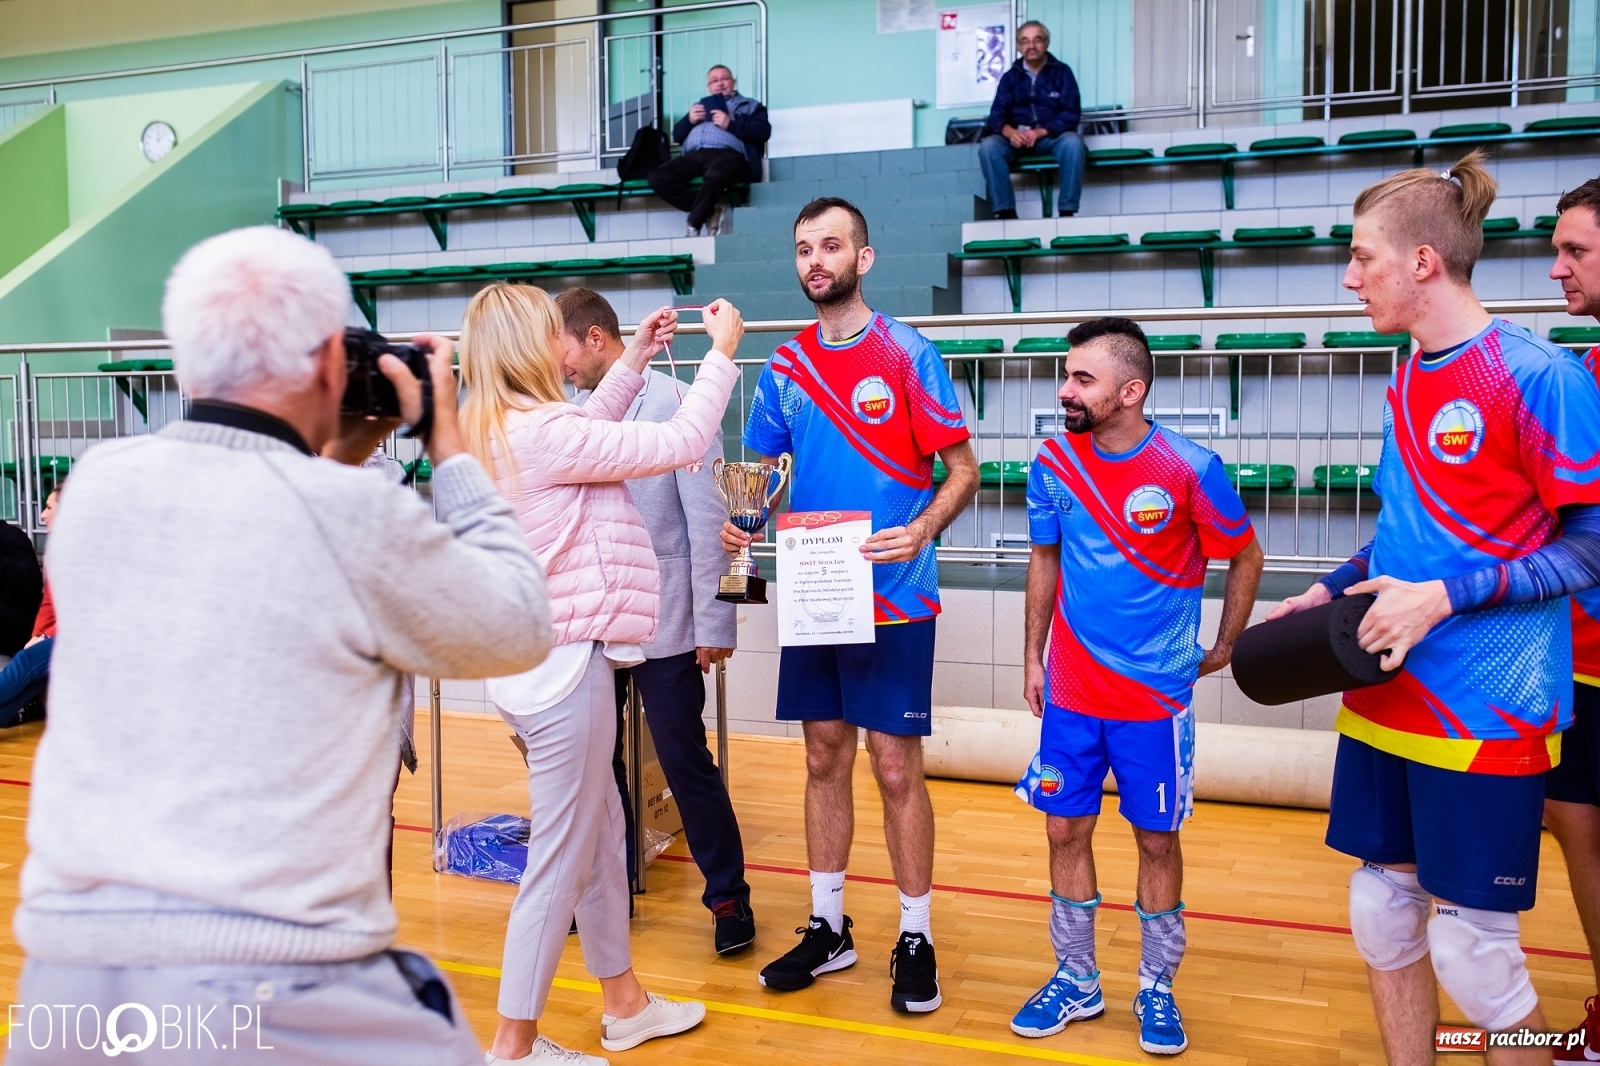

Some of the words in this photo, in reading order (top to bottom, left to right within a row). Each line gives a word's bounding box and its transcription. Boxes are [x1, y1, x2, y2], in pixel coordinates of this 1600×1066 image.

[865, 401, 886, 412] ŚWIT
[1442, 455, 1460, 464] 1992
[1138, 512, 1164, 522] ŚWIT
[802, 536, 843, 545] DYPLOM
[1156, 783, 1167, 812] 1
